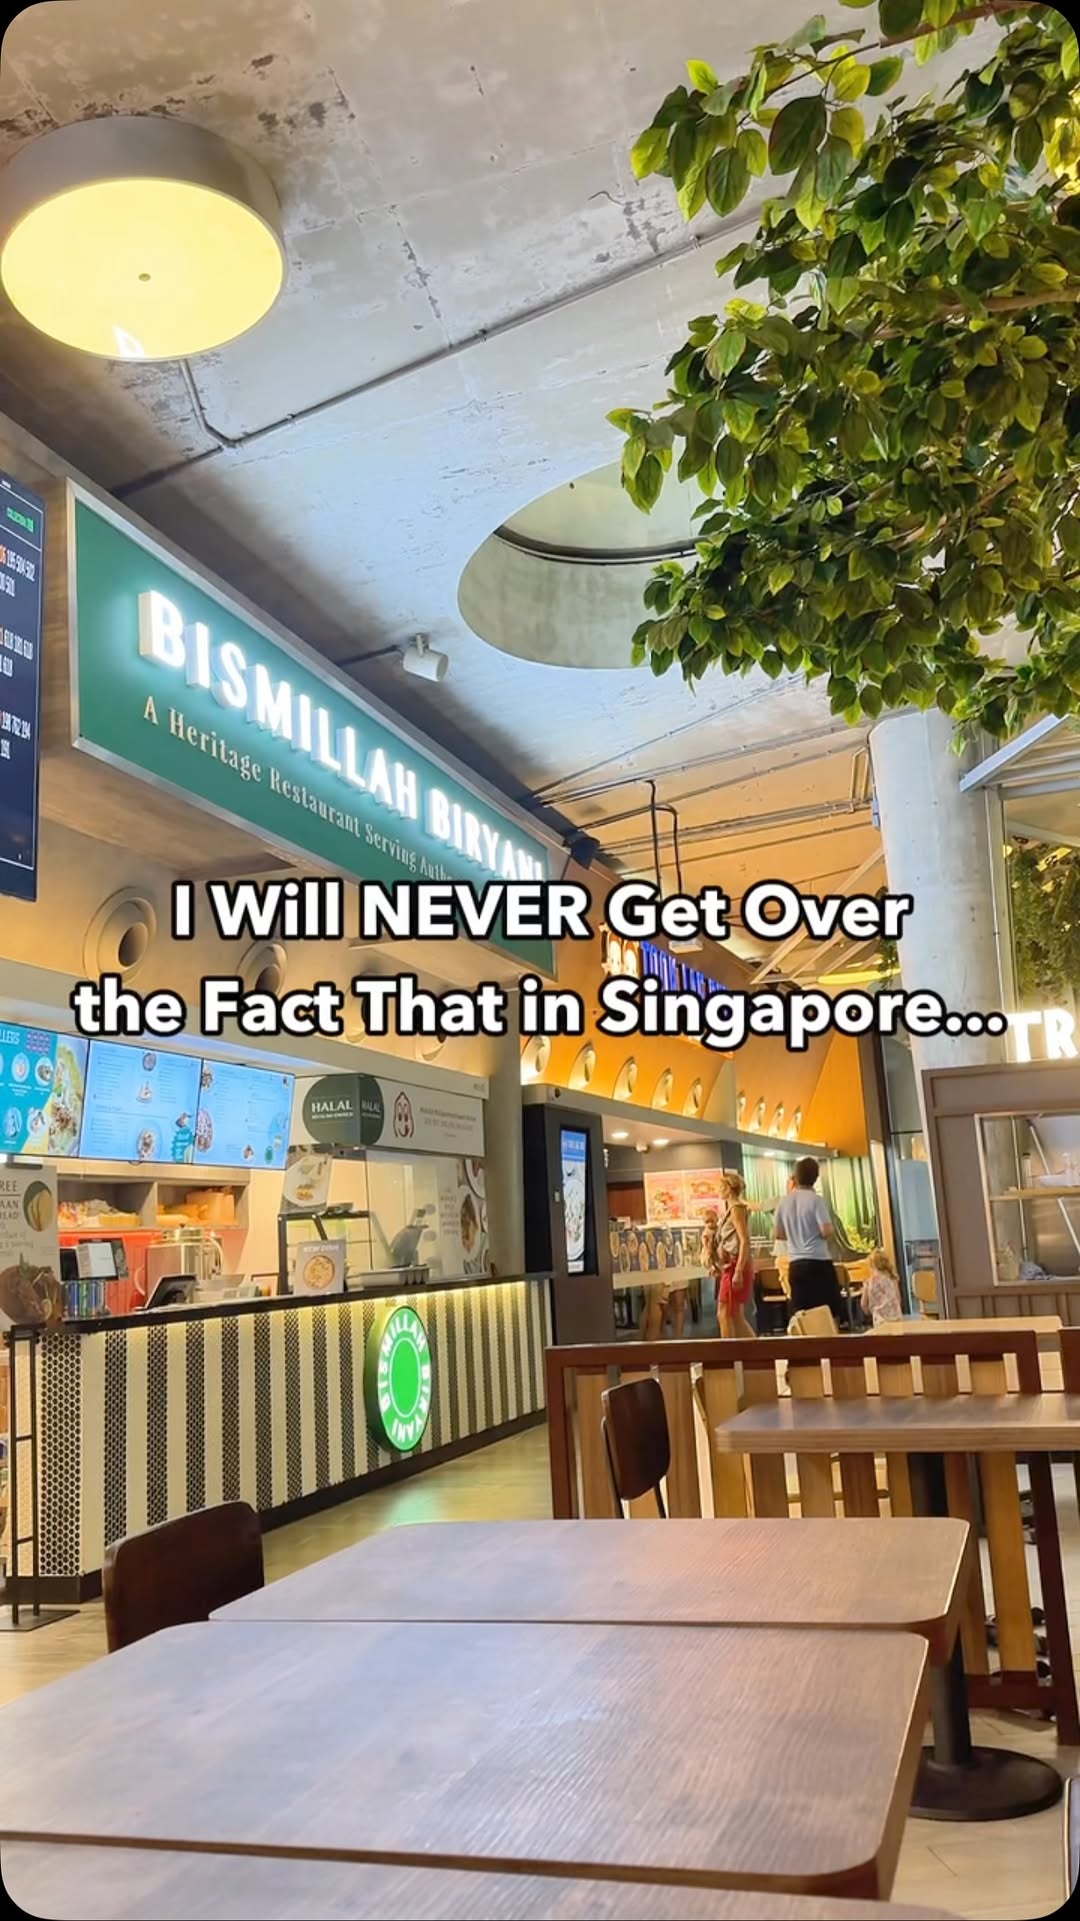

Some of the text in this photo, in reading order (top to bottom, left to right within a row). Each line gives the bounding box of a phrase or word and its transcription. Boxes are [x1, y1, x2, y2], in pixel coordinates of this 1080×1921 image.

[138, 590, 418, 820] BISMILLAH
[143, 695, 158, 726] A
[169, 707, 262, 783] Heritage
[269, 766, 361, 838] Restaurant
[365, 823, 417, 873] Serving
[311, 1100, 353, 1113] HALAL
[378, 1312, 431, 1443] BISMILLAH BIRYANI
